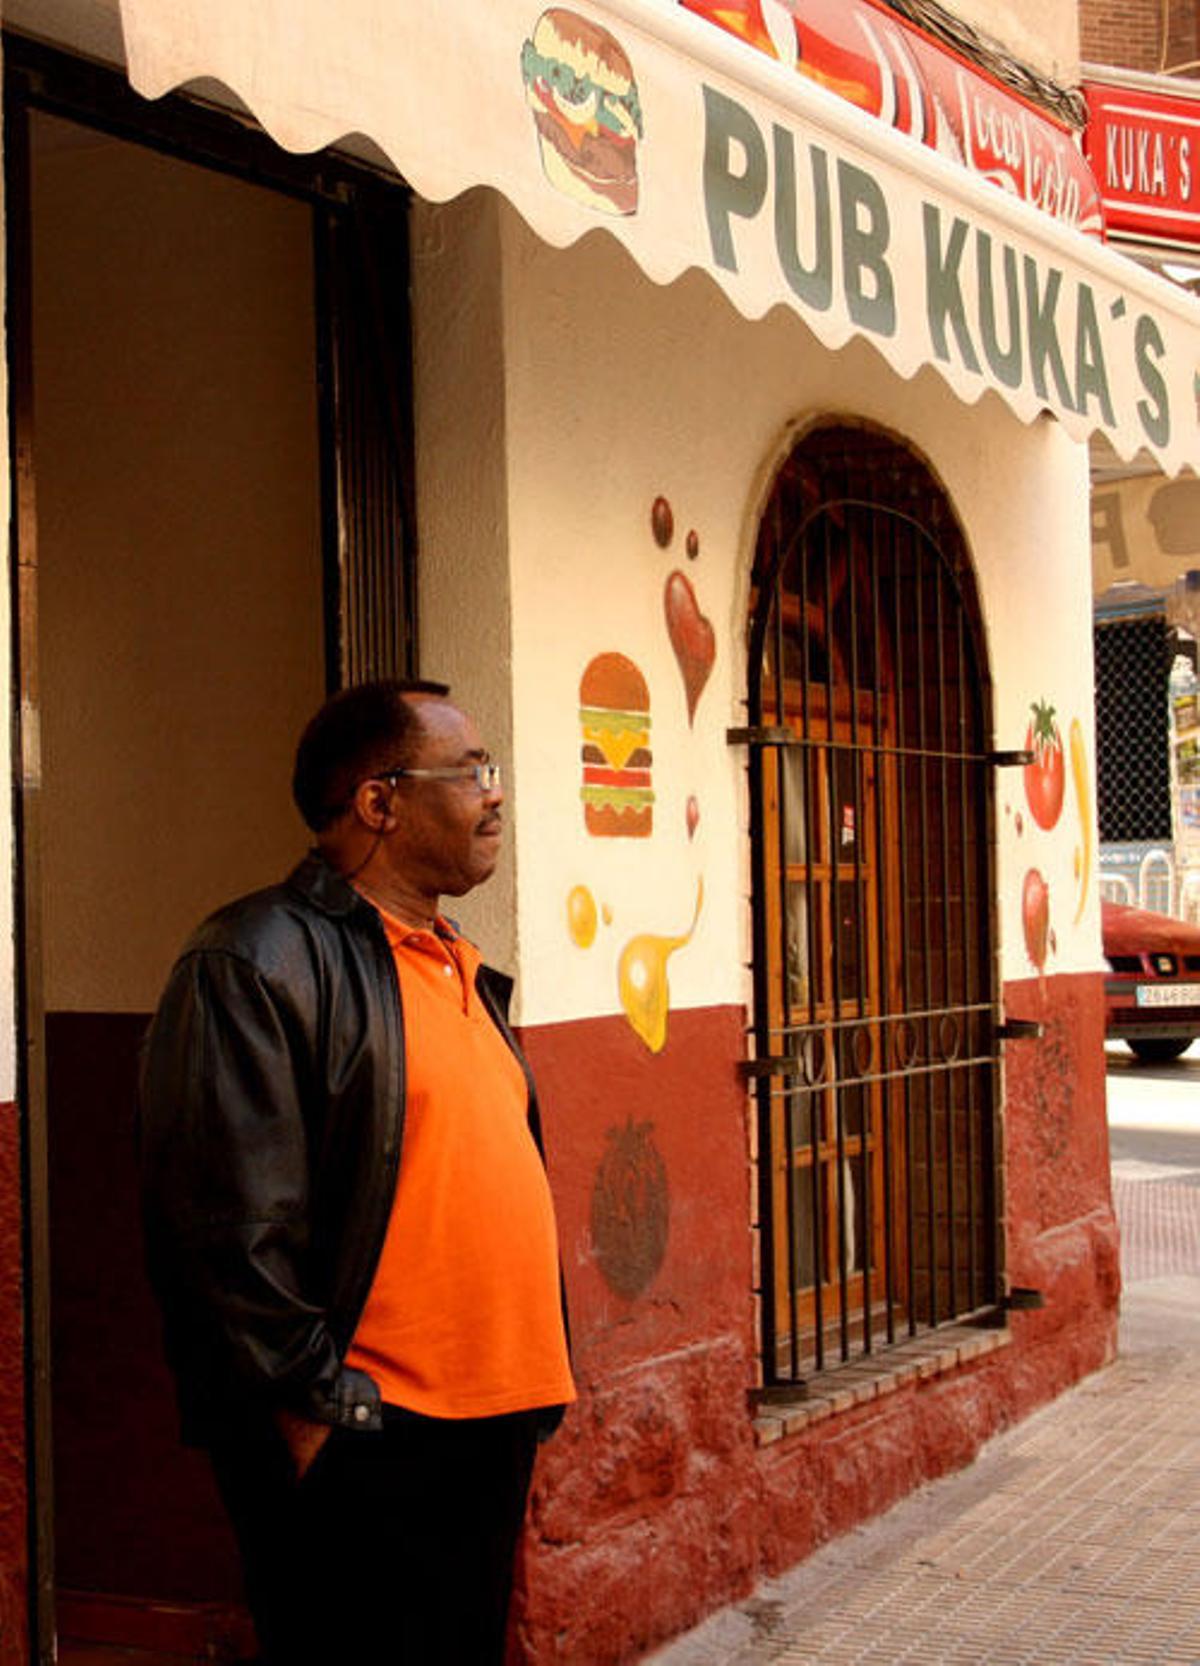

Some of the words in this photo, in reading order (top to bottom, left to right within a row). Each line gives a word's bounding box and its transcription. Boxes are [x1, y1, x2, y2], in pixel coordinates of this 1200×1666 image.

[702, 83, 896, 339] PUB
[922, 201, 1169, 448] KUKA'S
[1105, 123, 1191, 201] KUKA'S
